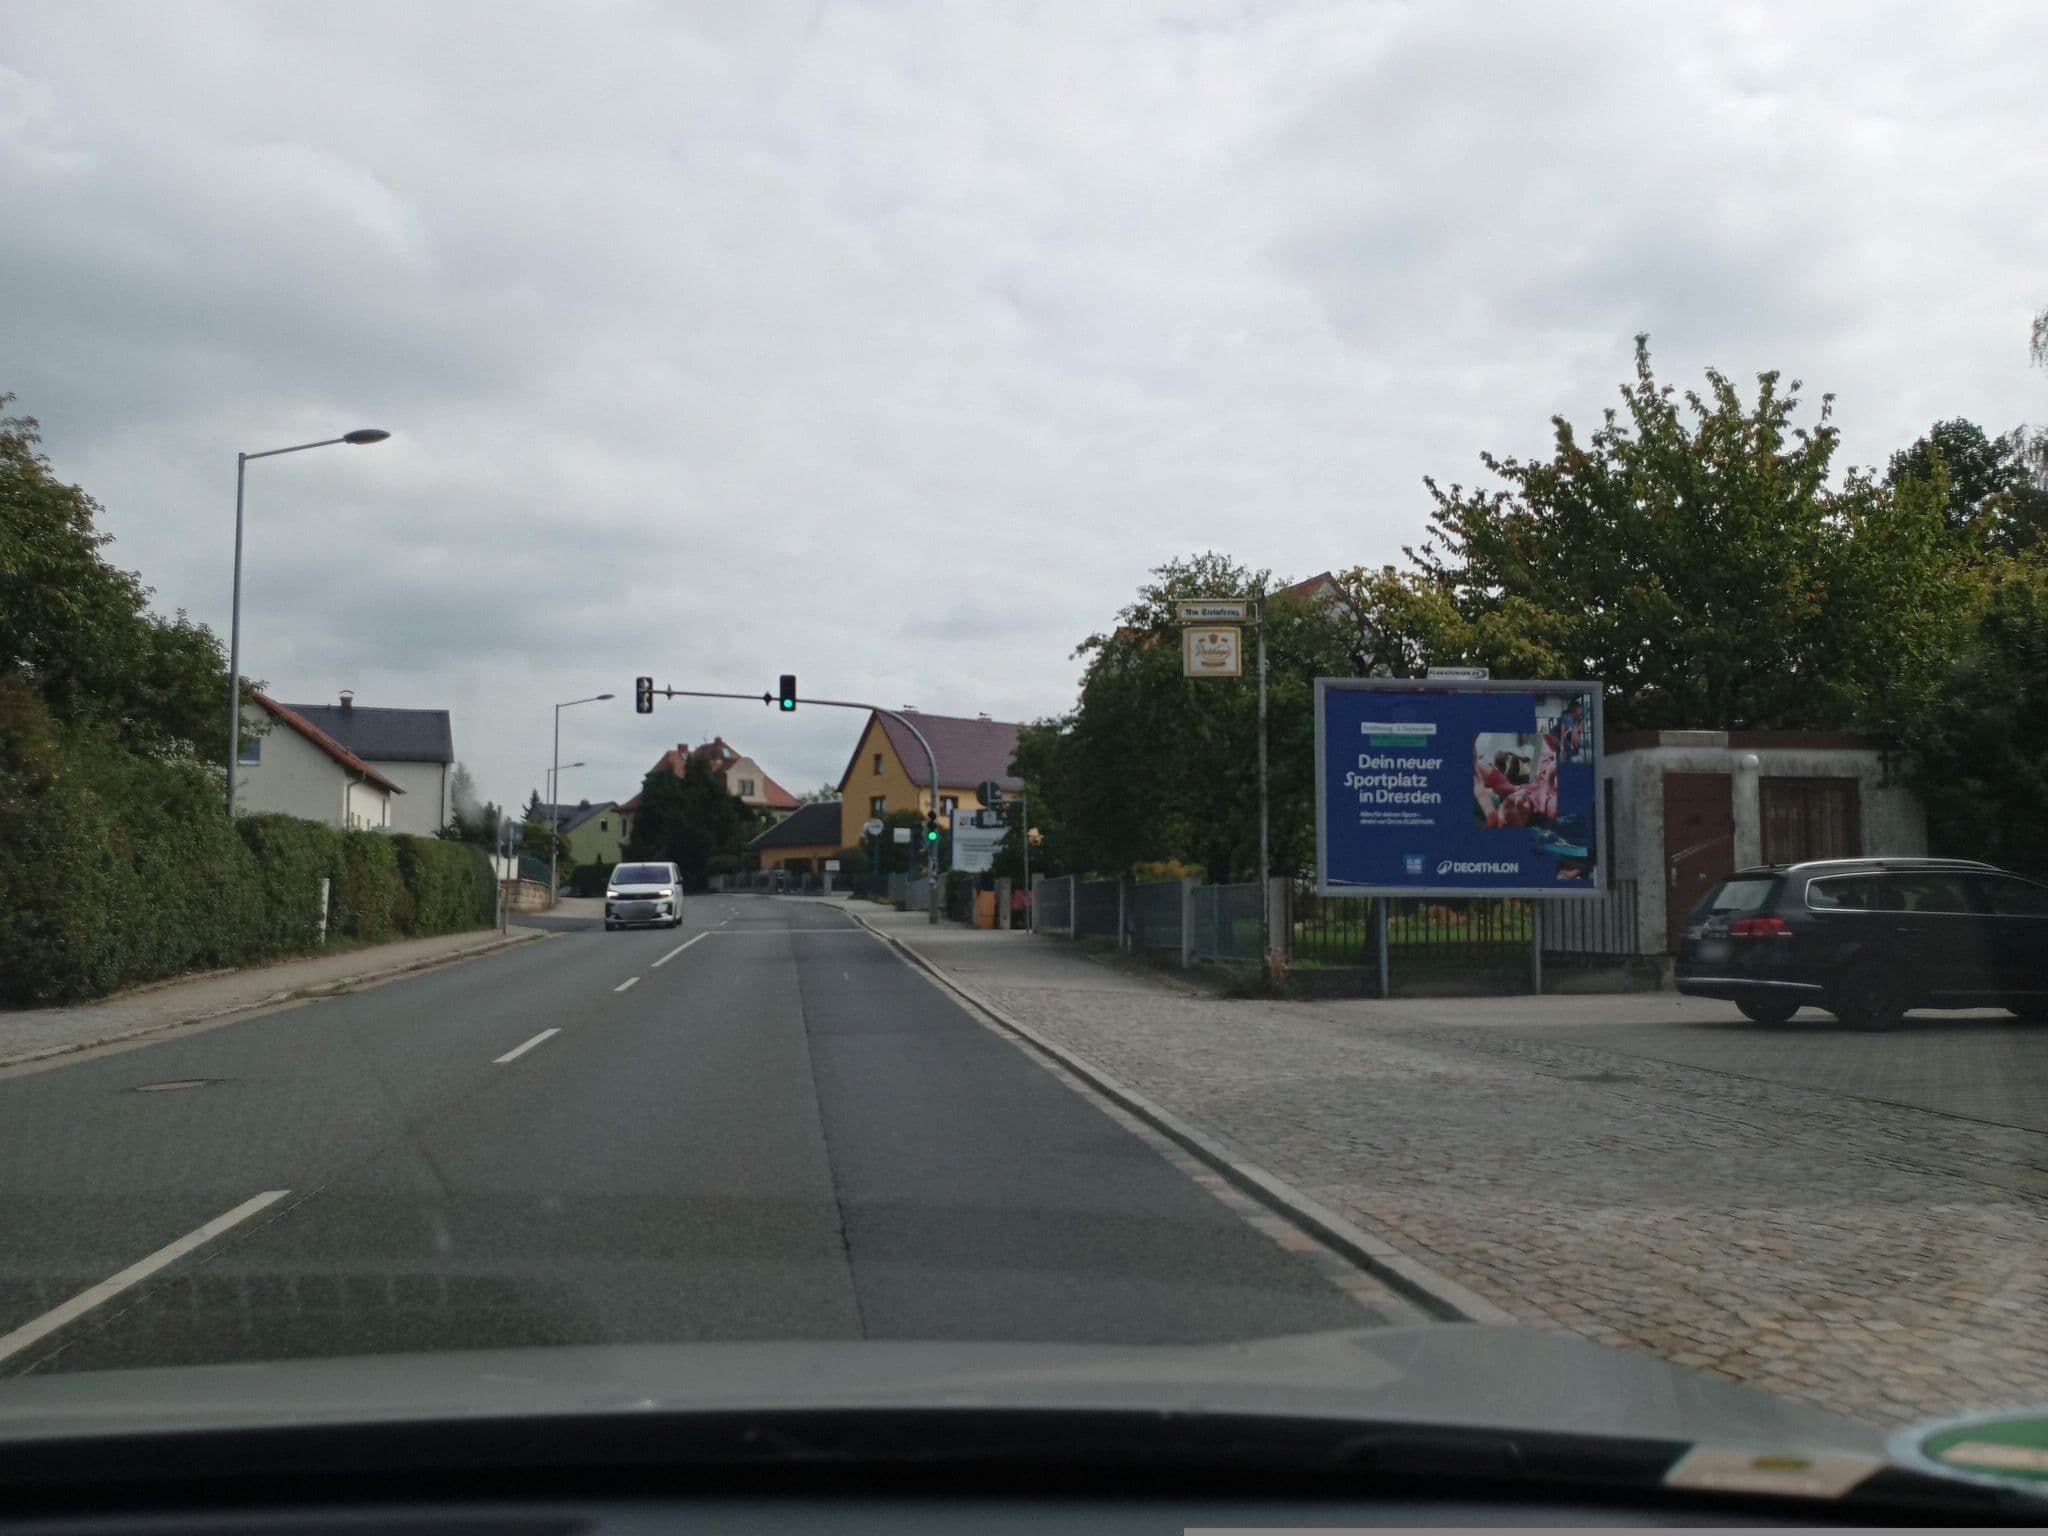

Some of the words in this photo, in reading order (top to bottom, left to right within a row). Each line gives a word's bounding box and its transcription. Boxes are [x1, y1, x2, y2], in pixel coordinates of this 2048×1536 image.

[1358, 754, 1395, 769] Dein
[1396, 758, 1443, 769] neuer
[1344, 772, 1428, 789] Sportplatz
[1359, 789, 1373, 803] in
[1375, 789, 1442, 804] Dresden
[1453, 862, 1519, 873] DECATHLON
